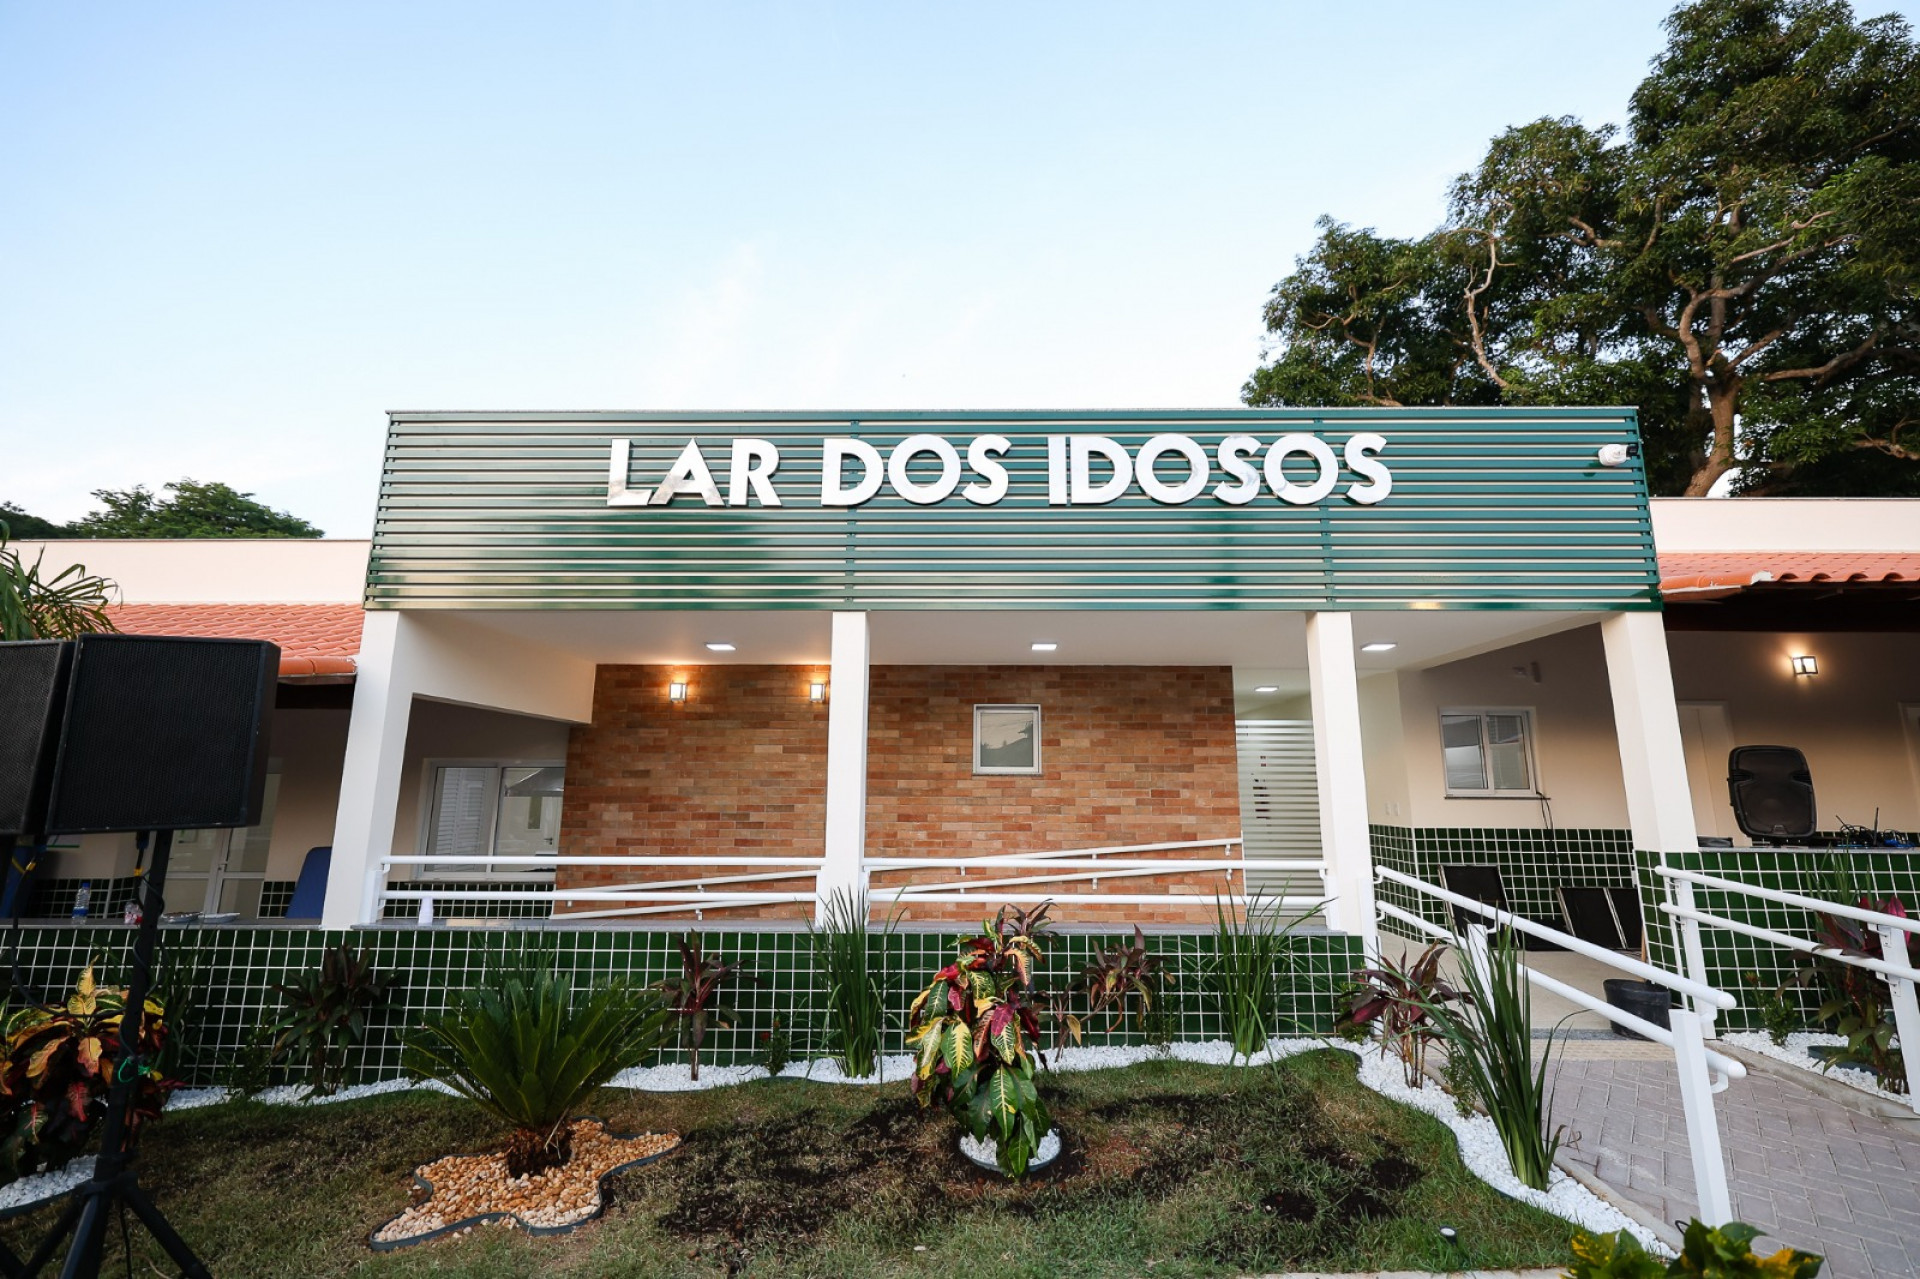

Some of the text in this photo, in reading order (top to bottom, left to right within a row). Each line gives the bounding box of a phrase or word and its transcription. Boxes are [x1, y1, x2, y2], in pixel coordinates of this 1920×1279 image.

[606, 432, 1393, 507] LAR DOS IDOSOS
